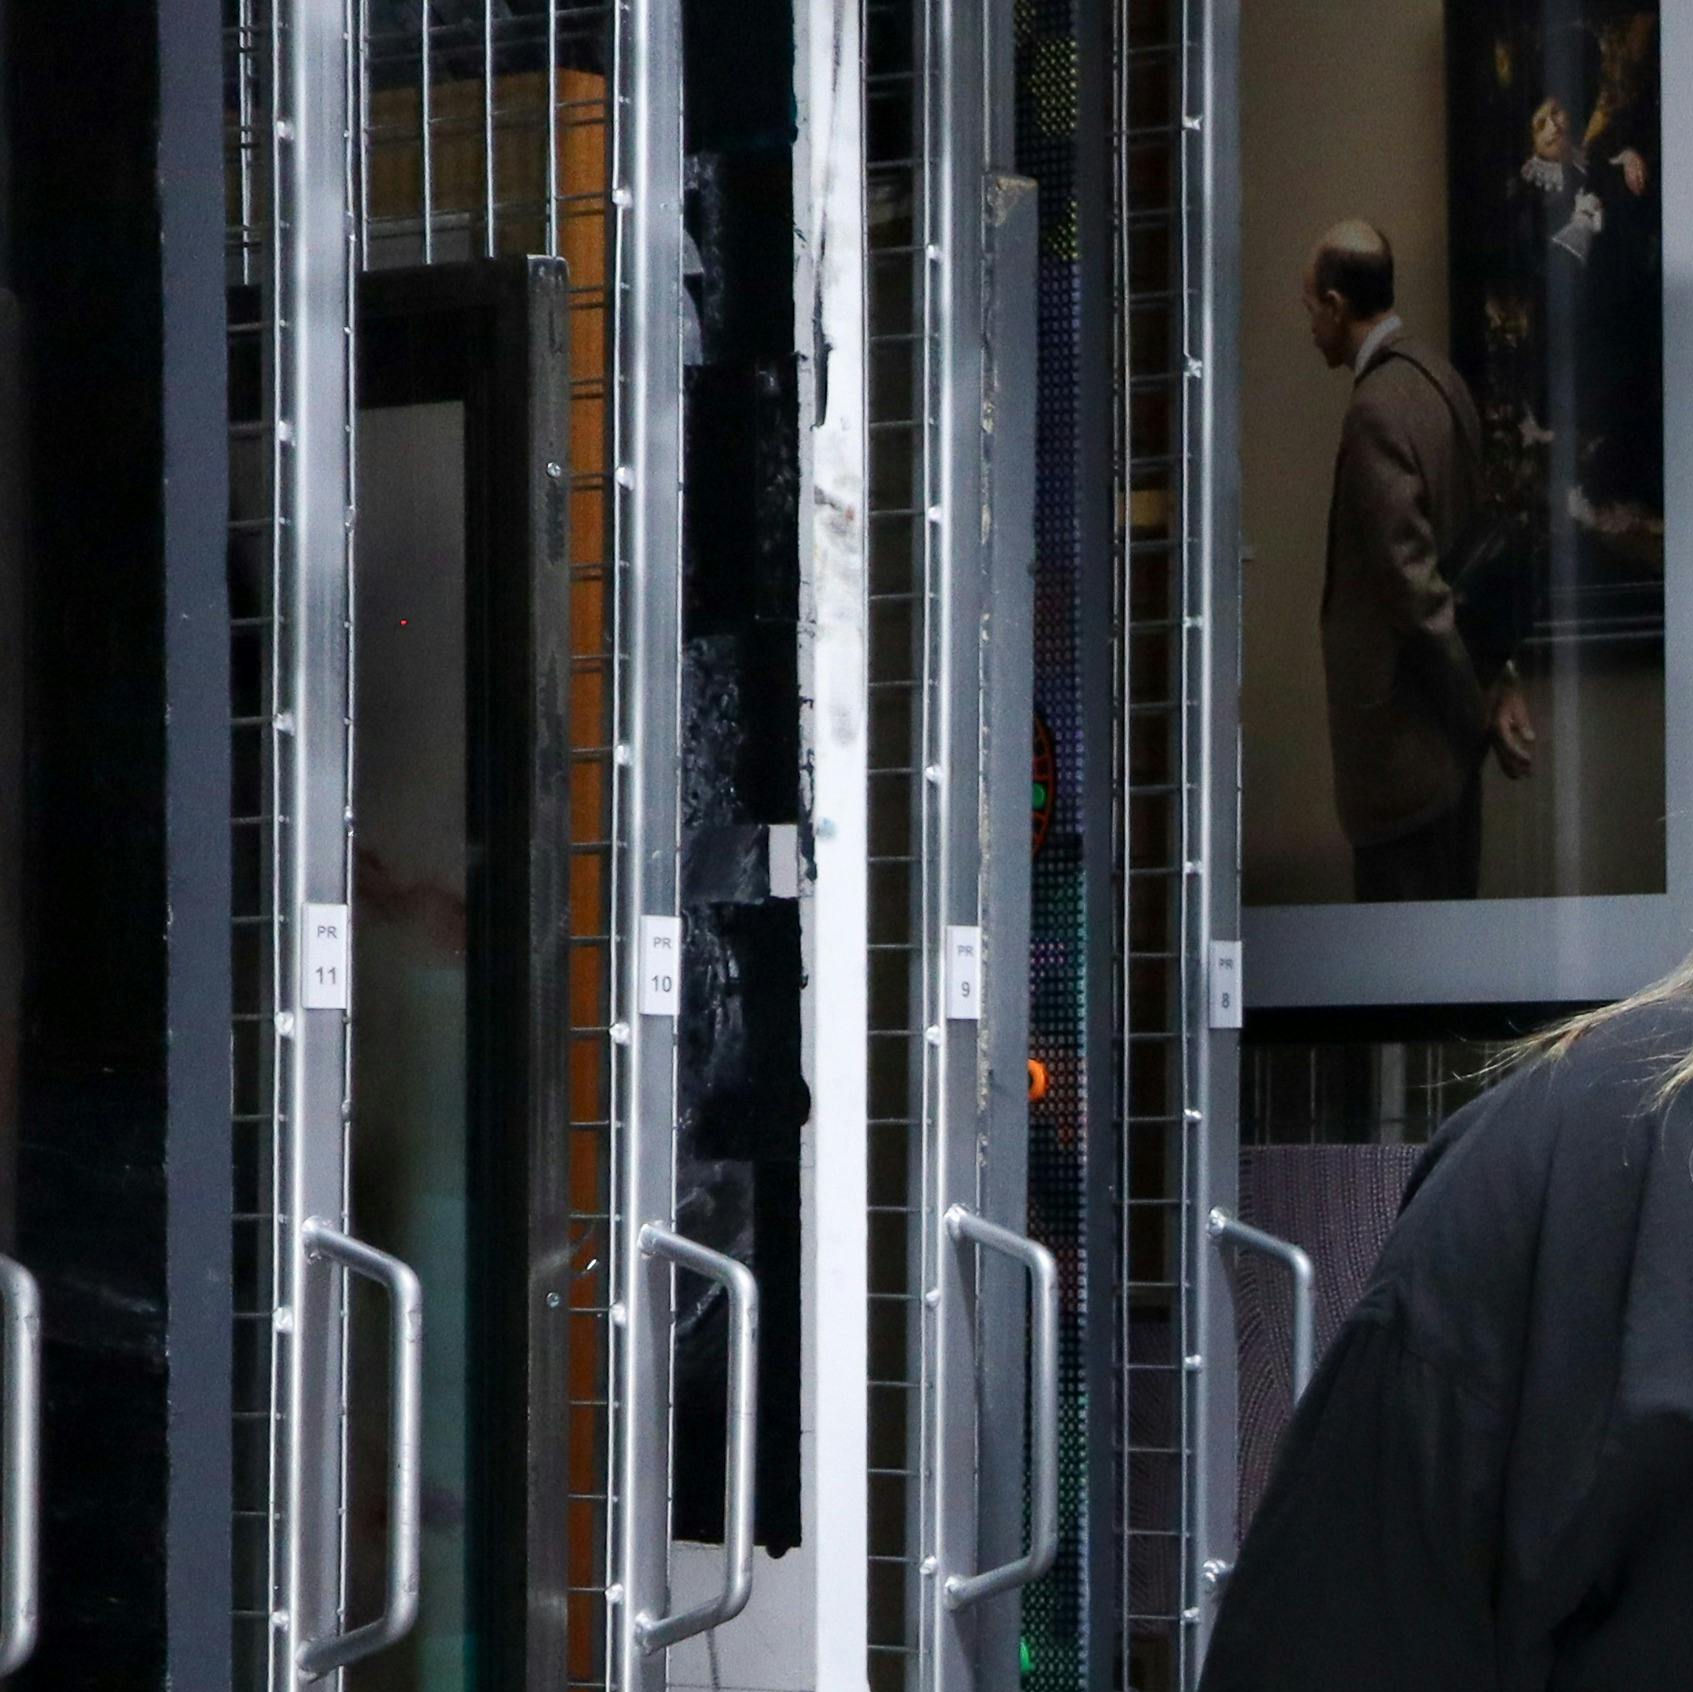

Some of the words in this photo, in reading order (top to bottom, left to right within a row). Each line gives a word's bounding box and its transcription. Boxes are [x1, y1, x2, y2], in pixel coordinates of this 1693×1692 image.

[317, 925, 338, 939] PR
[653, 936, 672, 949] PR
[957, 944, 975, 958] PR
[315, 966, 337, 985] 11
[651, 974, 673, 993] 10
[960, 981, 971, 998] 9
[1221, 992, 1230, 1009] 8
